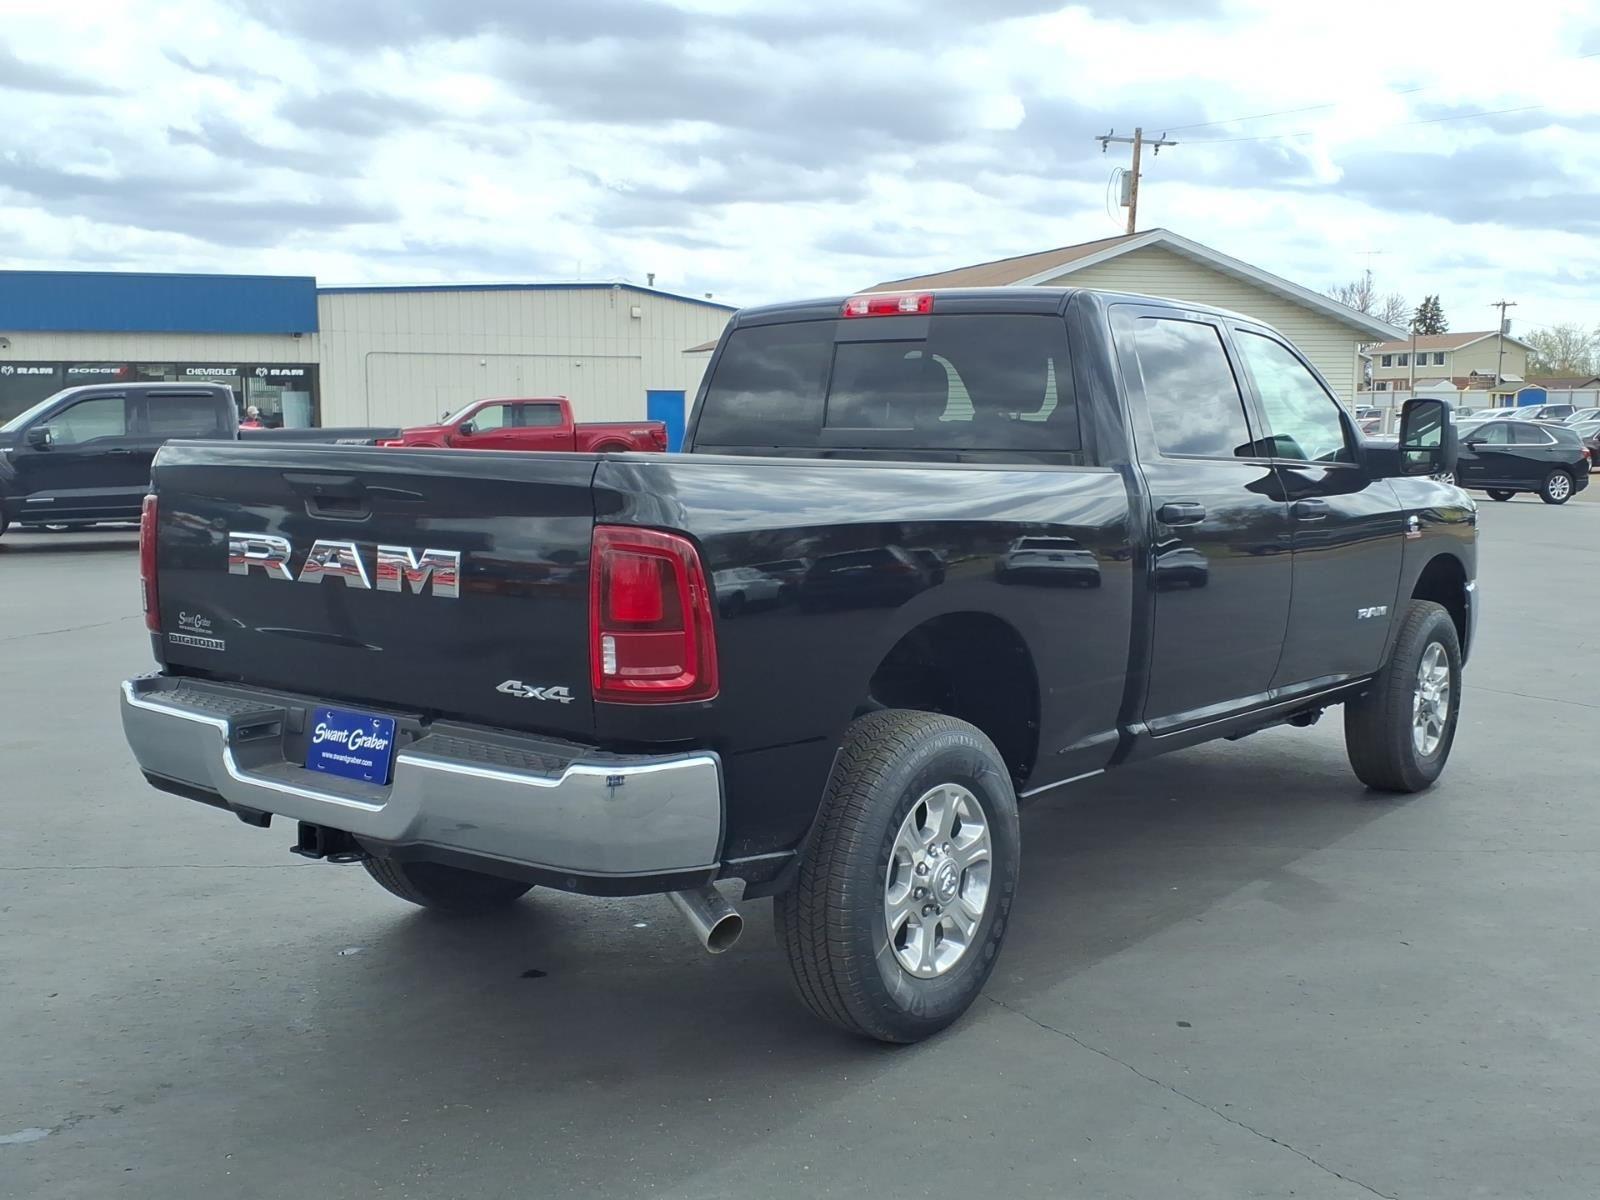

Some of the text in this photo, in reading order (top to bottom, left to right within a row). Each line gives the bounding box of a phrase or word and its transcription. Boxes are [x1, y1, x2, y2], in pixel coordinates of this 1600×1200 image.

[17, 367, 54, 375] RAM
[186, 368, 237, 376] CHEVROLET
[228, 531, 461, 599] RAM
[312, 722, 388, 751] Swant Graber
